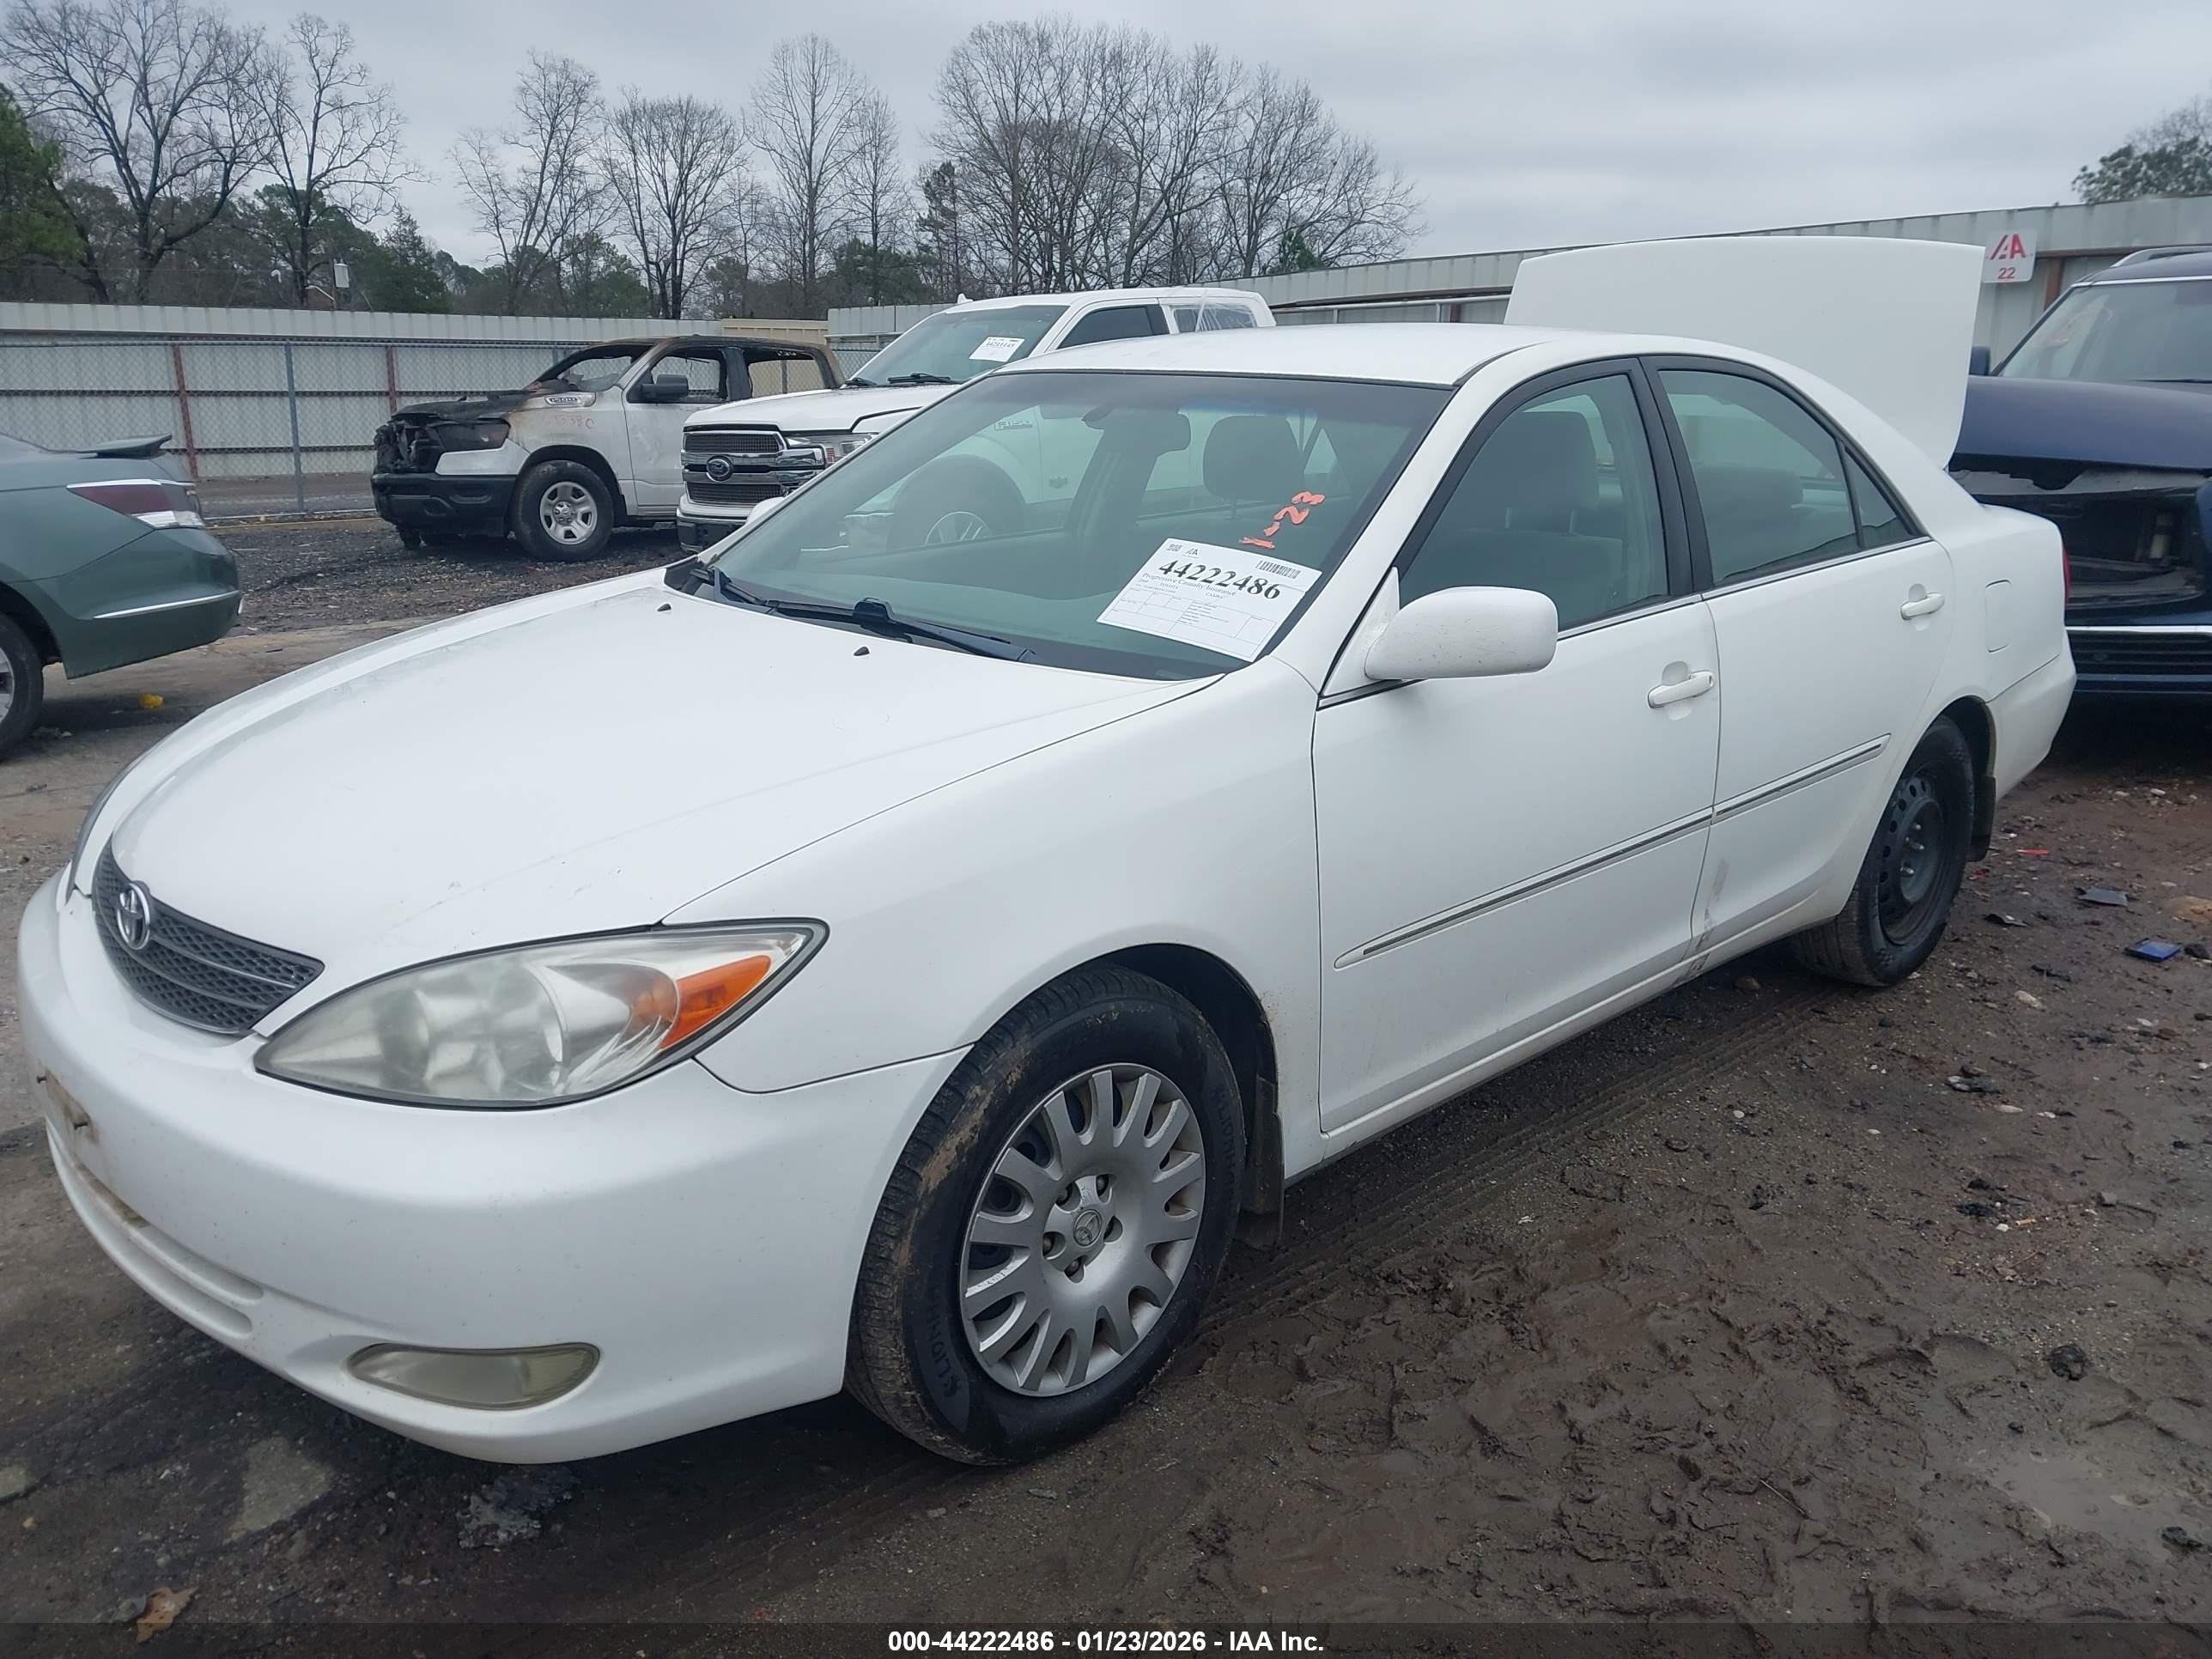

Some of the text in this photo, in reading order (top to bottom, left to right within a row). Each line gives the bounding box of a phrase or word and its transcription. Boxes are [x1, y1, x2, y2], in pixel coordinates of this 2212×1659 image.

[1998, 267, 2016, 279] 22
[1158, 560, 1281, 599] 44222486
[1178, 580, 1203, 589] Casualty
[1206, 586, 1237, 596] Insurance
